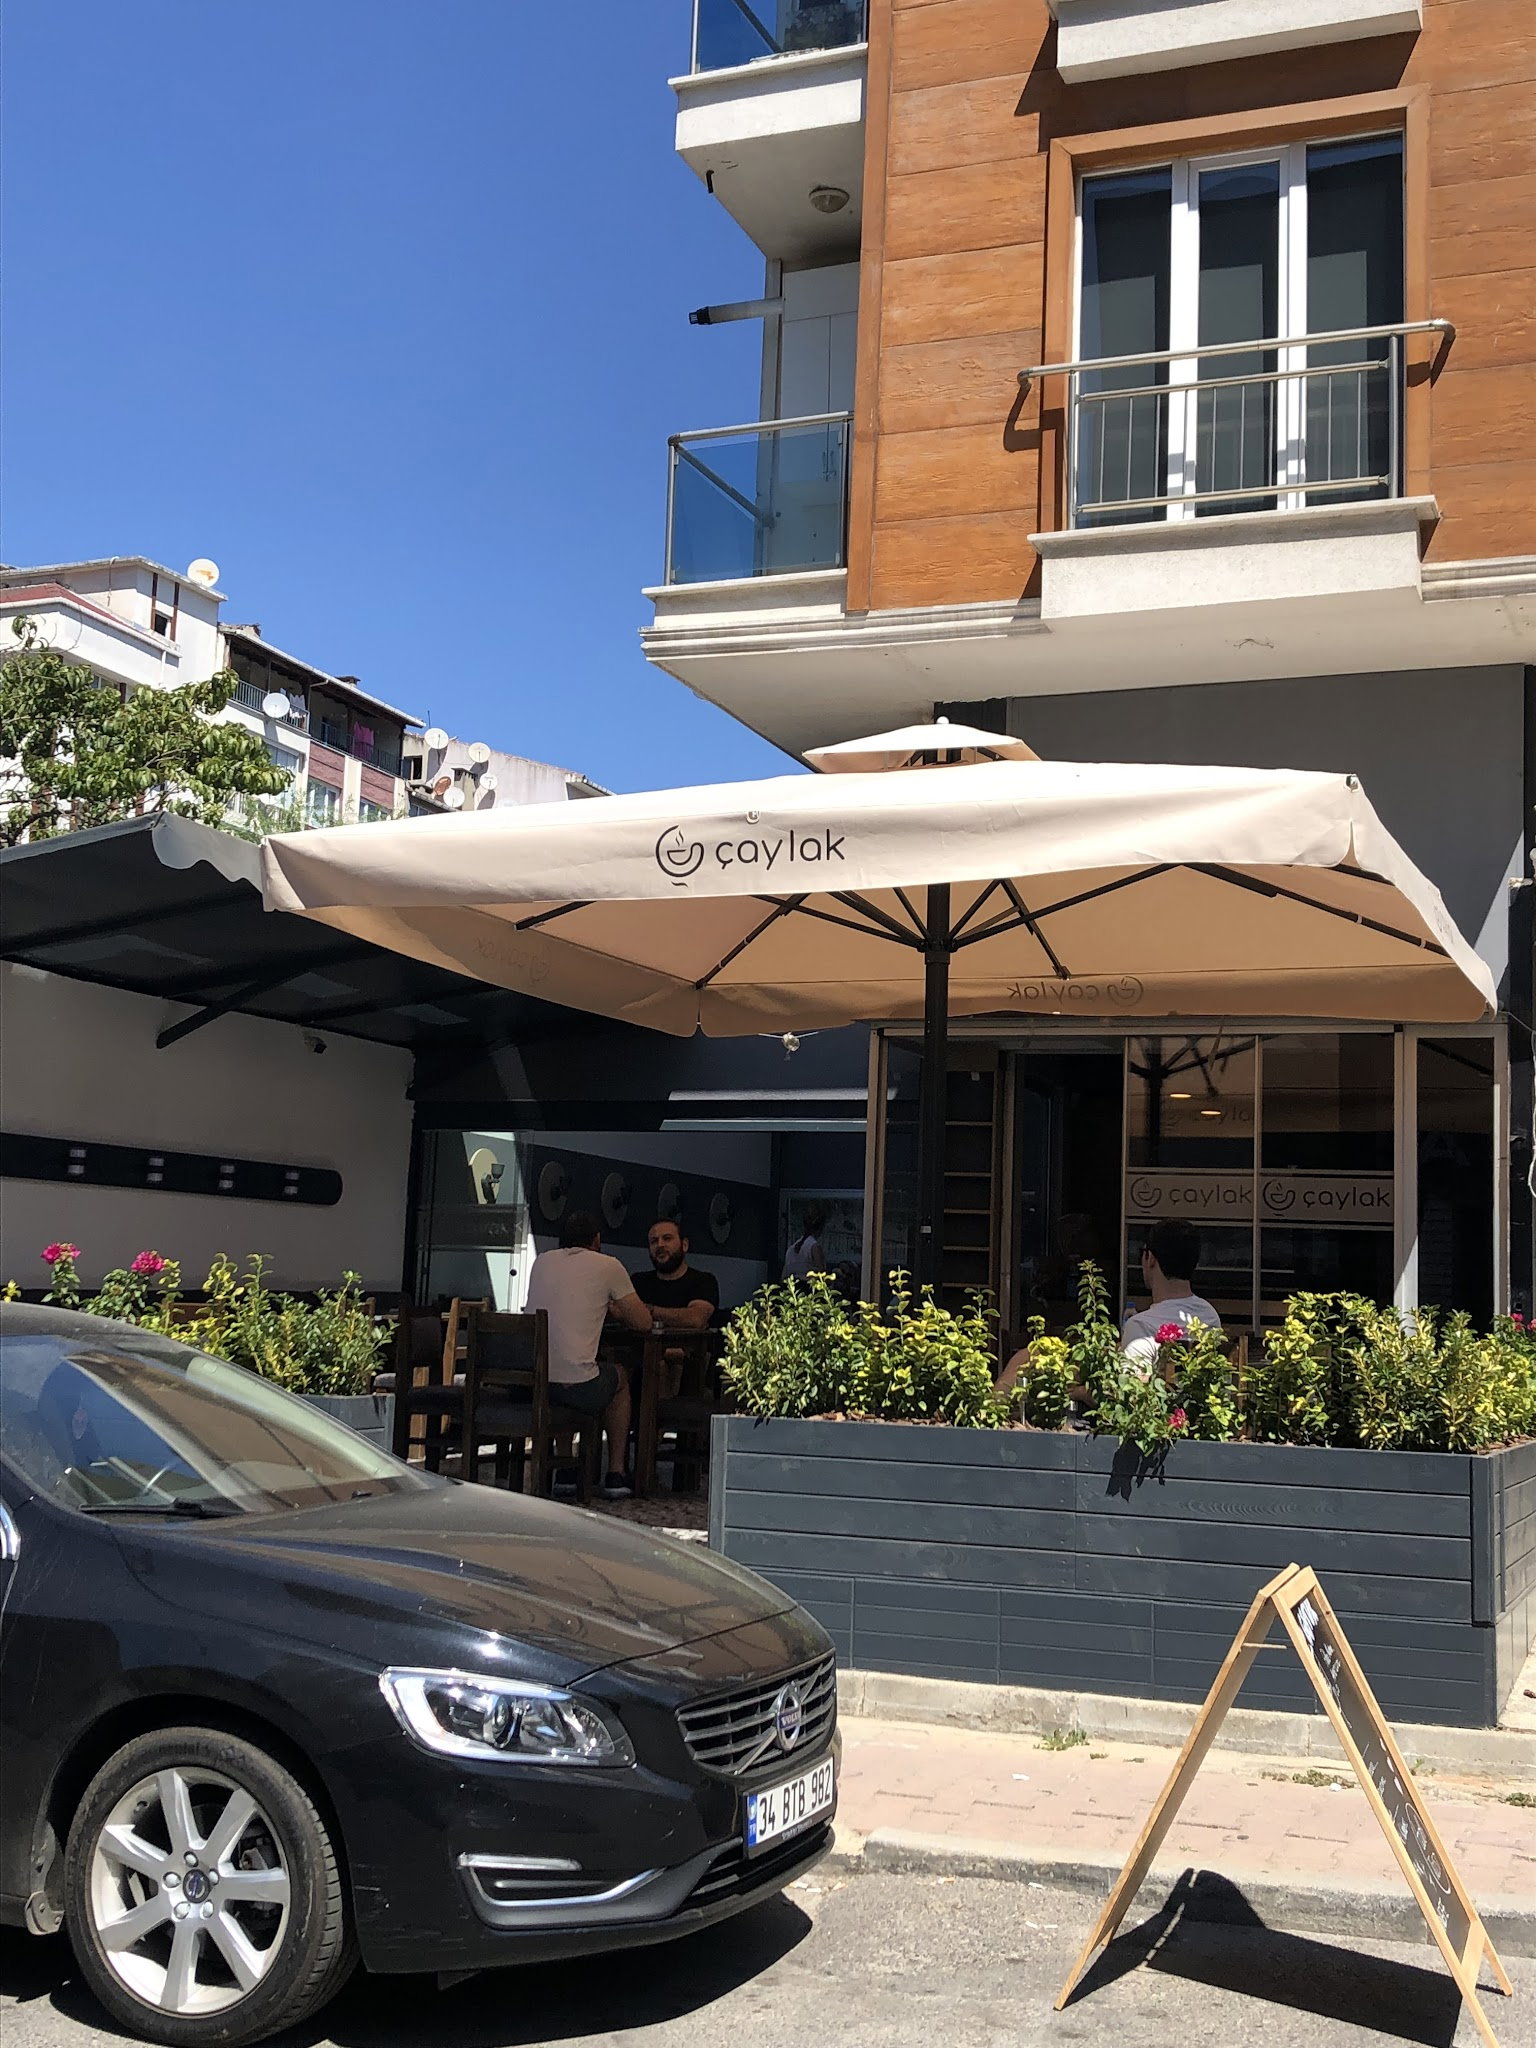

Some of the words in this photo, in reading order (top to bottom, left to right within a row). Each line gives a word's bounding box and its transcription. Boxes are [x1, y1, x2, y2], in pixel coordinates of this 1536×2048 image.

[715, 829, 845, 870] çaylak
[1170, 1185, 1252, 1207] çaylak
[1303, 1187, 1390, 1210] çaylak
[759, 1793, 776, 1836] 34
[783, 1778, 806, 1825] BTB
[811, 1765, 832, 1809] 982
